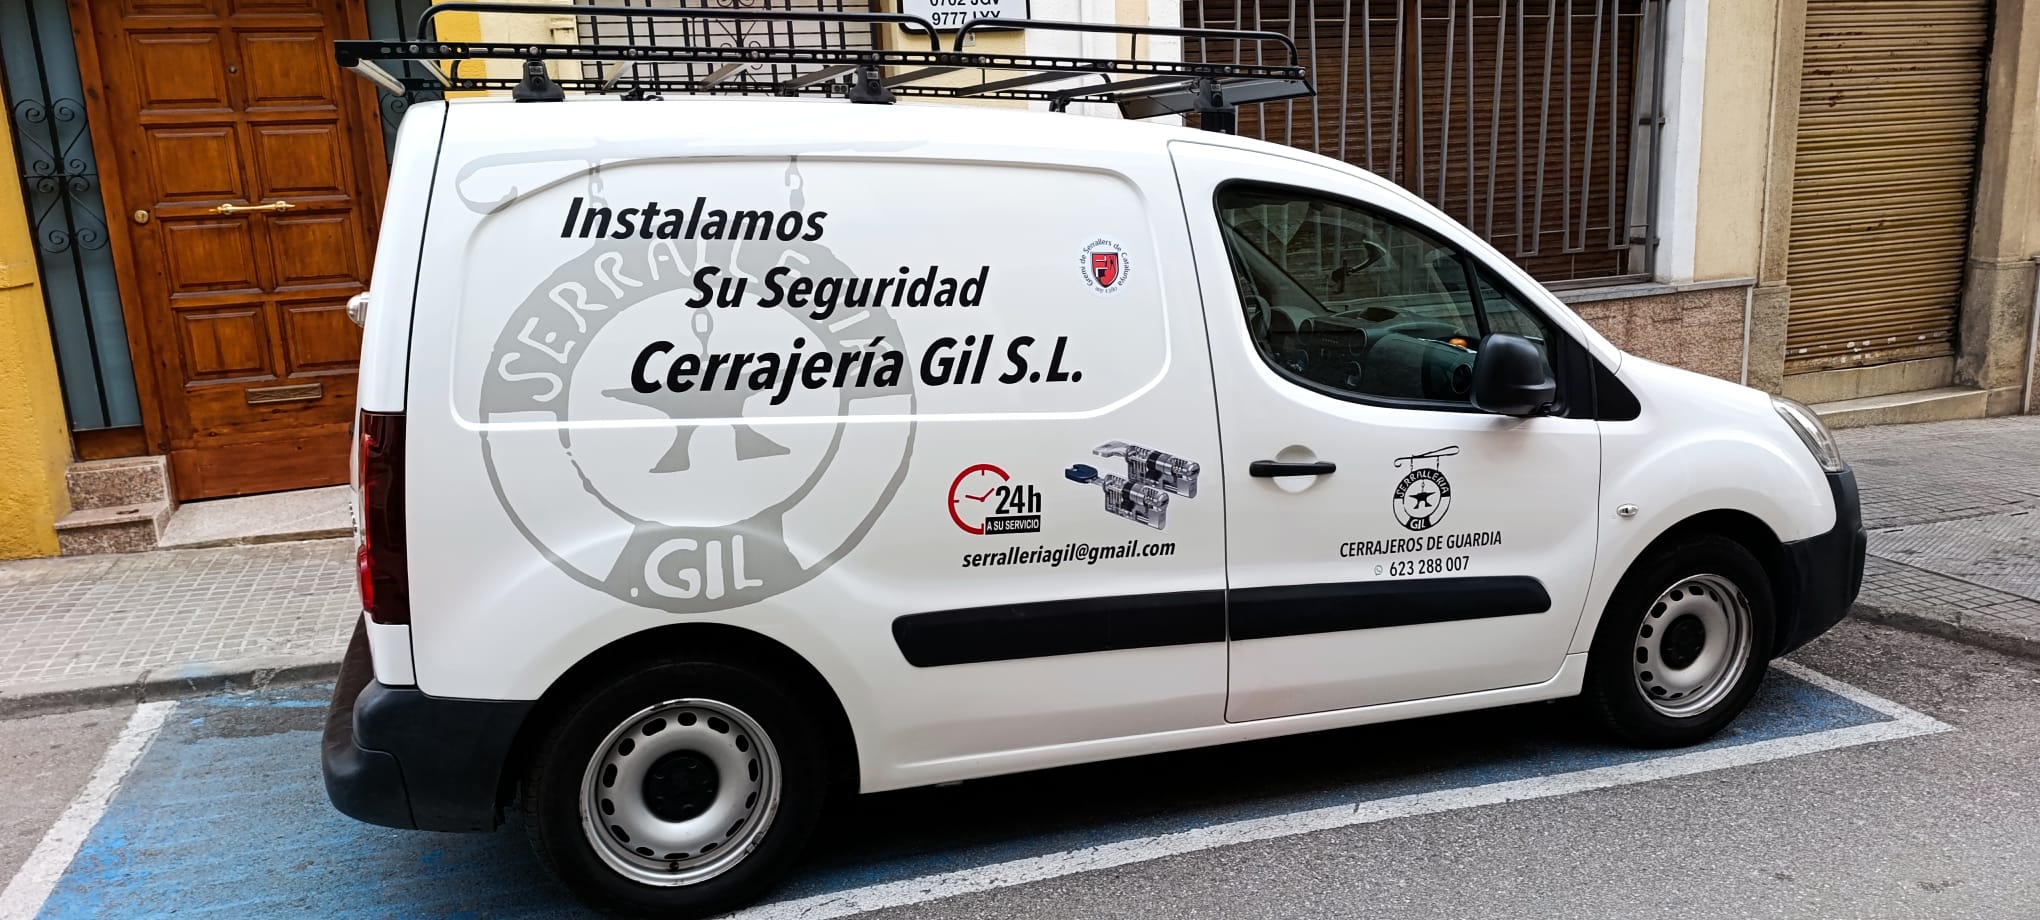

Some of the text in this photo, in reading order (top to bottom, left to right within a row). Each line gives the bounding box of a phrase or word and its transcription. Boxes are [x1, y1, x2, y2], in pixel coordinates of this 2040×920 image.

[931, 12, 967, 25] 9777
[561, 197, 828, 242] Instalamos
[685, 265, 990, 321] Su Seguridad
[631, 334, 1083, 406] Cerrajería Gil S.L.
[1396, 470, 1449, 497] SERRALLERIA
[995, 484, 1042, 515] 24h
[986, 518, 1040, 531] A SU SERVICIO
[1410, 518, 1427, 530] GIL
[962, 540, 1177, 568] serralleriagil@gmail.com
[1339, 530, 1503, 558] CERRAJEROS DE GUARDIA
[1389, 555, 1470, 577] 623 288 007
